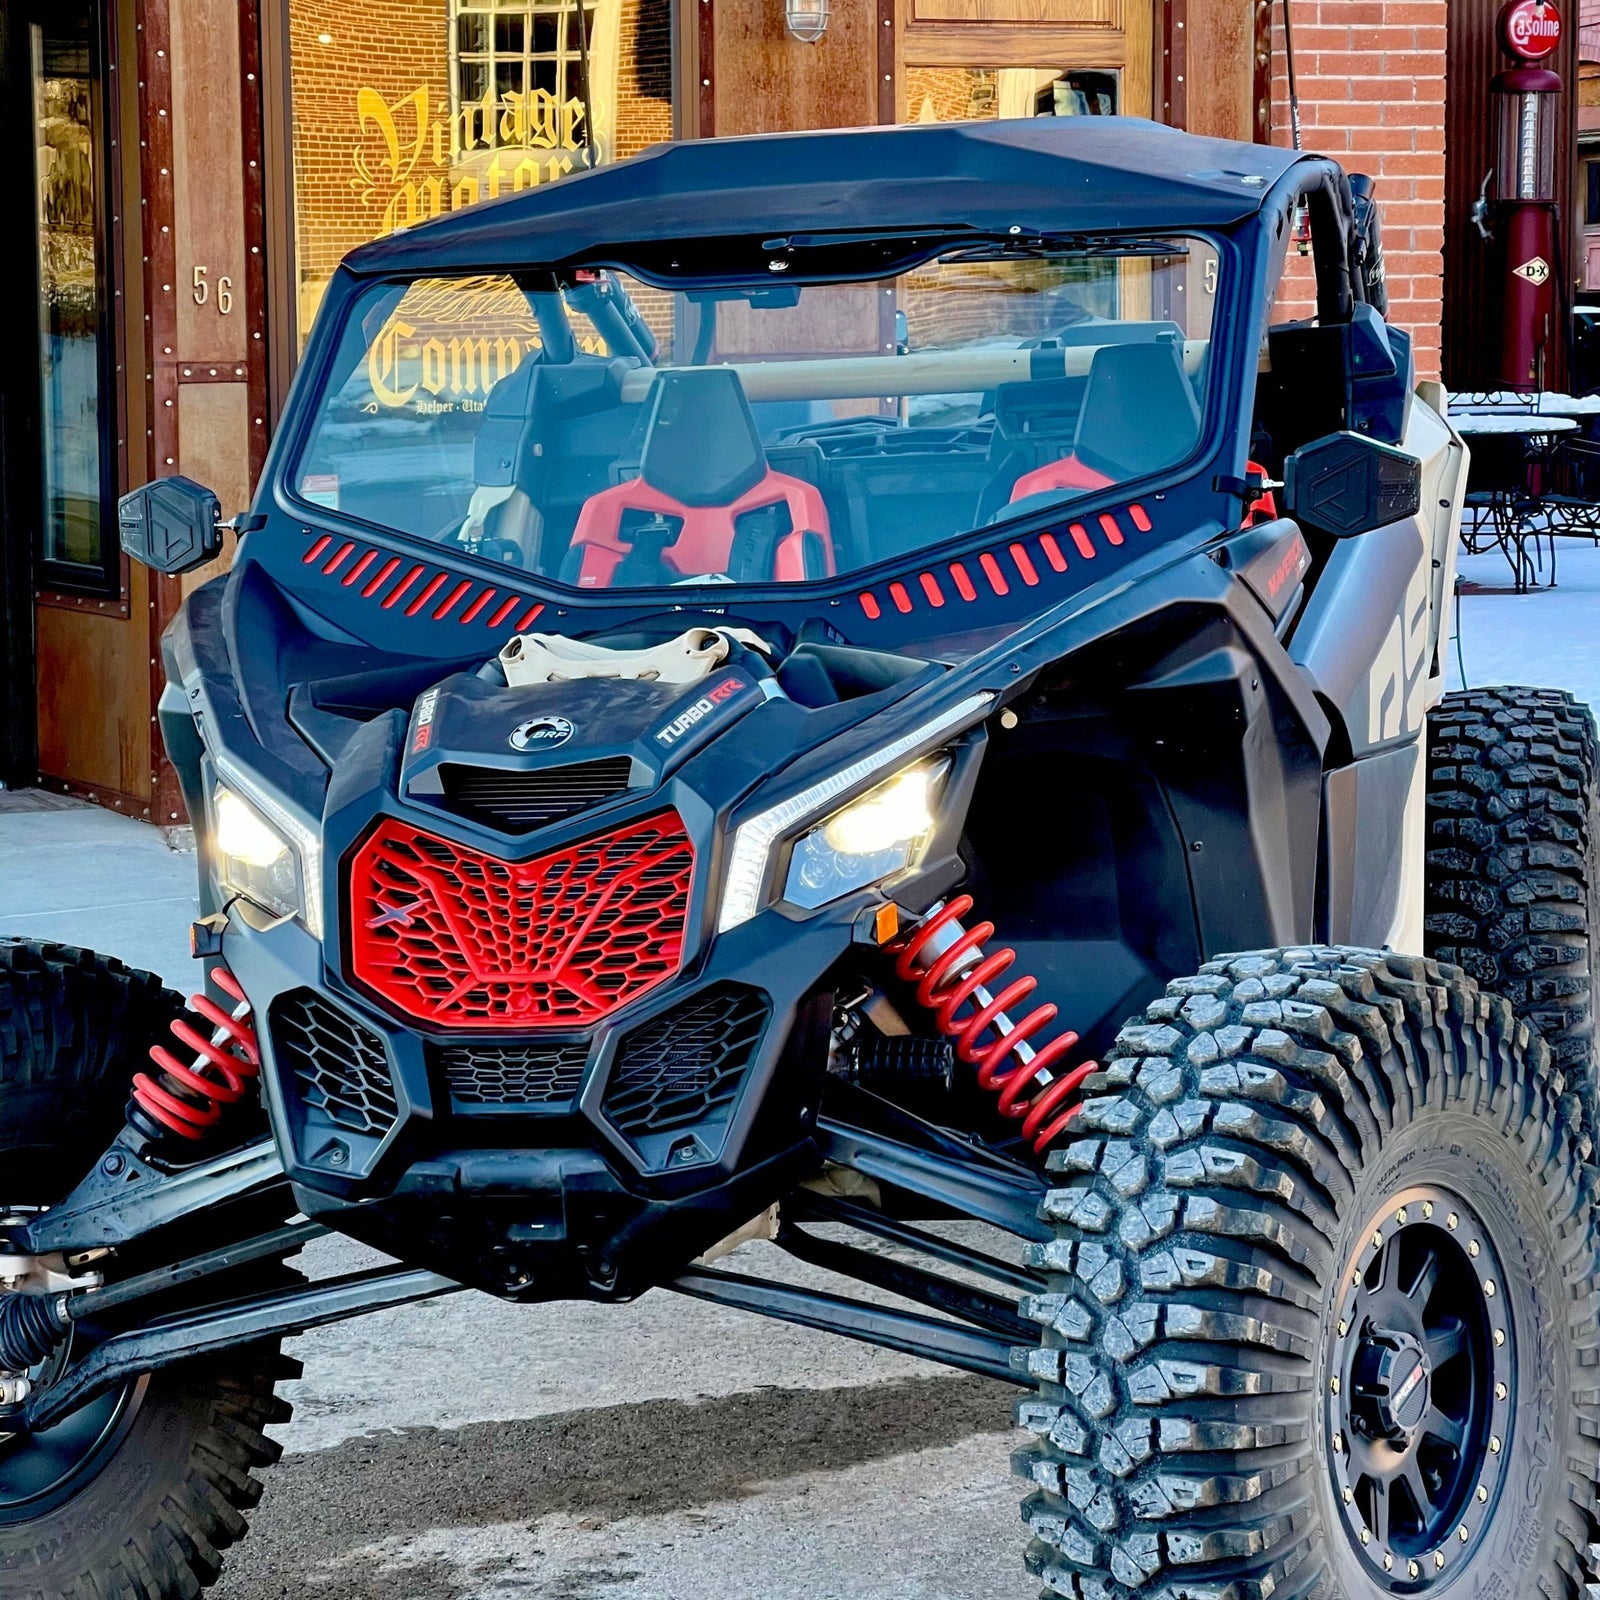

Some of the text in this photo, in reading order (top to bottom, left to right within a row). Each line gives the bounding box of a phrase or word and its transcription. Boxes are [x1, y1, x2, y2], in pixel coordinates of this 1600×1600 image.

[1510, 11, 1560, 45] Gasoline
[357, 83, 586, 184] Vintage
[193, 265, 233, 315] 56
[1205, 259, 1217, 294] 5
[415, 399, 454, 415] Helper
[412, 688, 440, 753] TURBO RR
[656, 677, 746, 745] TURBO RR
[531, 729, 570, 741] BRP
